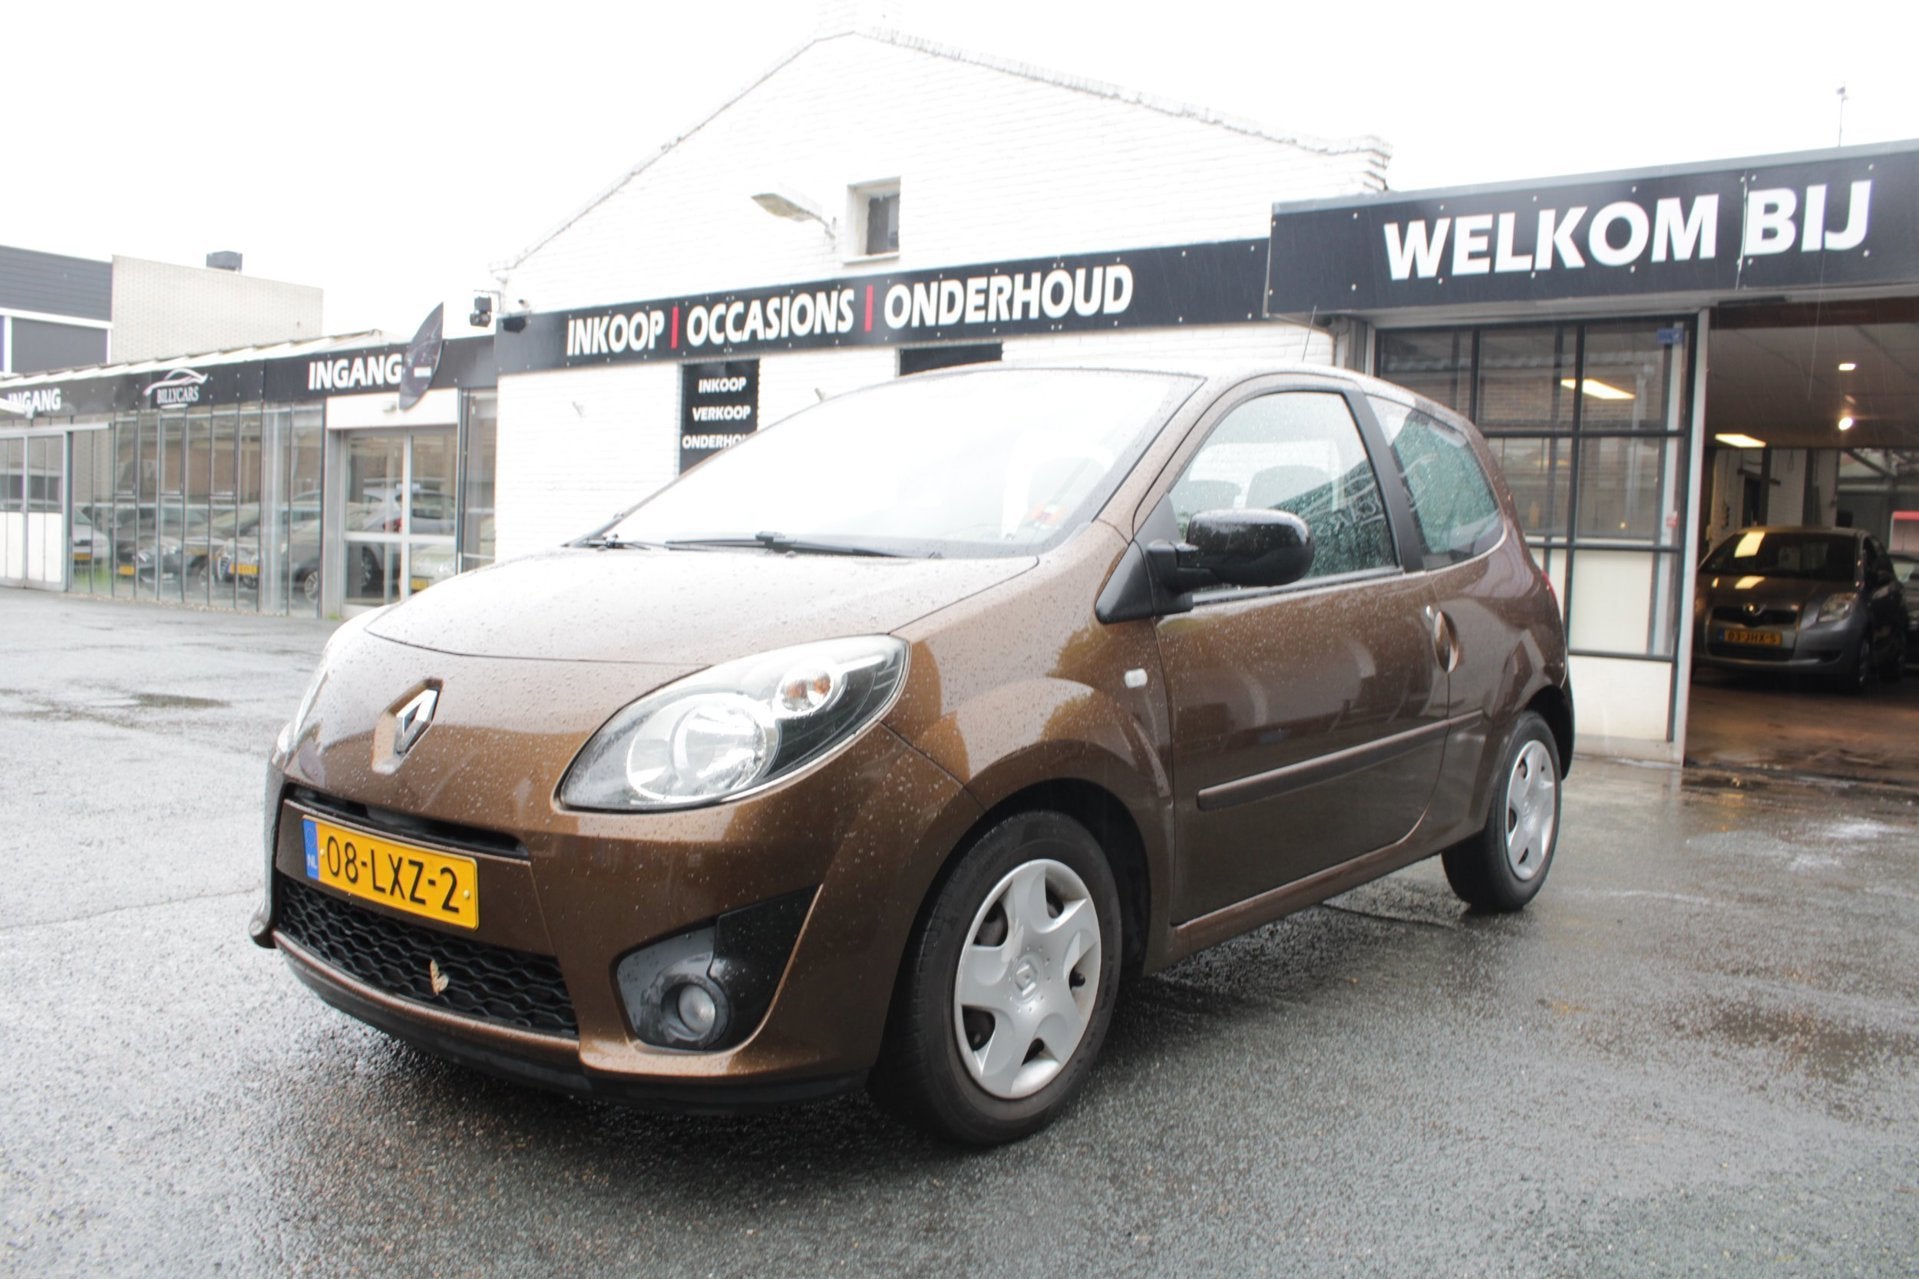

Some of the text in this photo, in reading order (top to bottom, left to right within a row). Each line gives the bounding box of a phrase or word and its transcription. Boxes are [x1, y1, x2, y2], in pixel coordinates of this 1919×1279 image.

[1383, 179, 1873, 282] WELKOM BIJ
[566, 264, 1134, 357] INKOOP OCCASIONS ONDERHOUD
[307, 353, 403, 391] INGANG
[698, 376, 747, 393] INKOOP
[156, 385, 200, 404] BILLYCARS
[692, 404, 752, 421] VERKOOP
[681, 433, 746, 449] ONDERHO
[306, 854, 318, 869] NL
[326, 835, 460, 914] 08-LXZ-2
